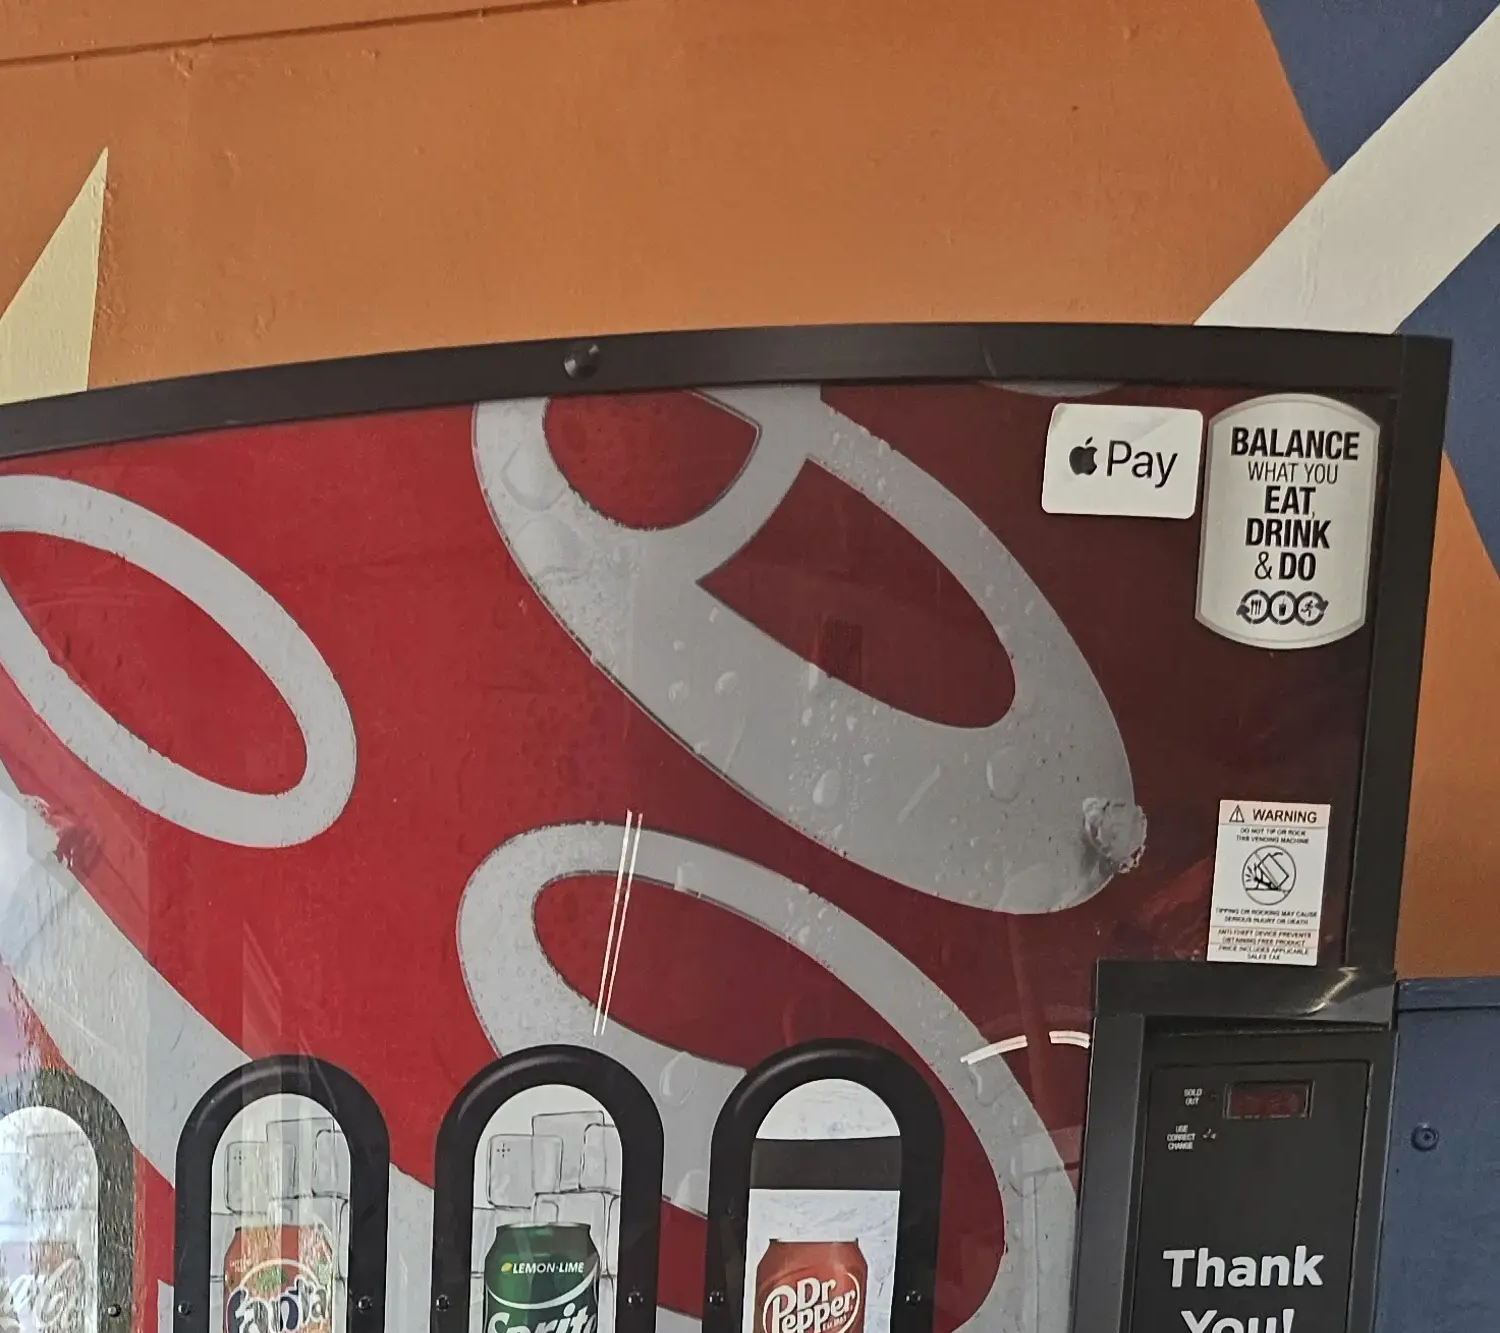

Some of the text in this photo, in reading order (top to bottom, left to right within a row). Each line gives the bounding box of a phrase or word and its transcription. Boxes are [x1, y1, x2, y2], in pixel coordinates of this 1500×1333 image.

[1230, 427, 1360, 461] BALANCE
[1106, 440, 1178, 489] Pay
[1247, 460, 1338, 485] WHAT YOU
[1264, 485, 1316, 519] EAT,
[1245, 518, 1331, 549] DRINK
[1254, 551, 1316, 581] & DO
[1252, 808, 1317, 823] WARNING
[1162, 1245, 1325, 1288] Thank
[797, 1277, 836, 1311] Dr
